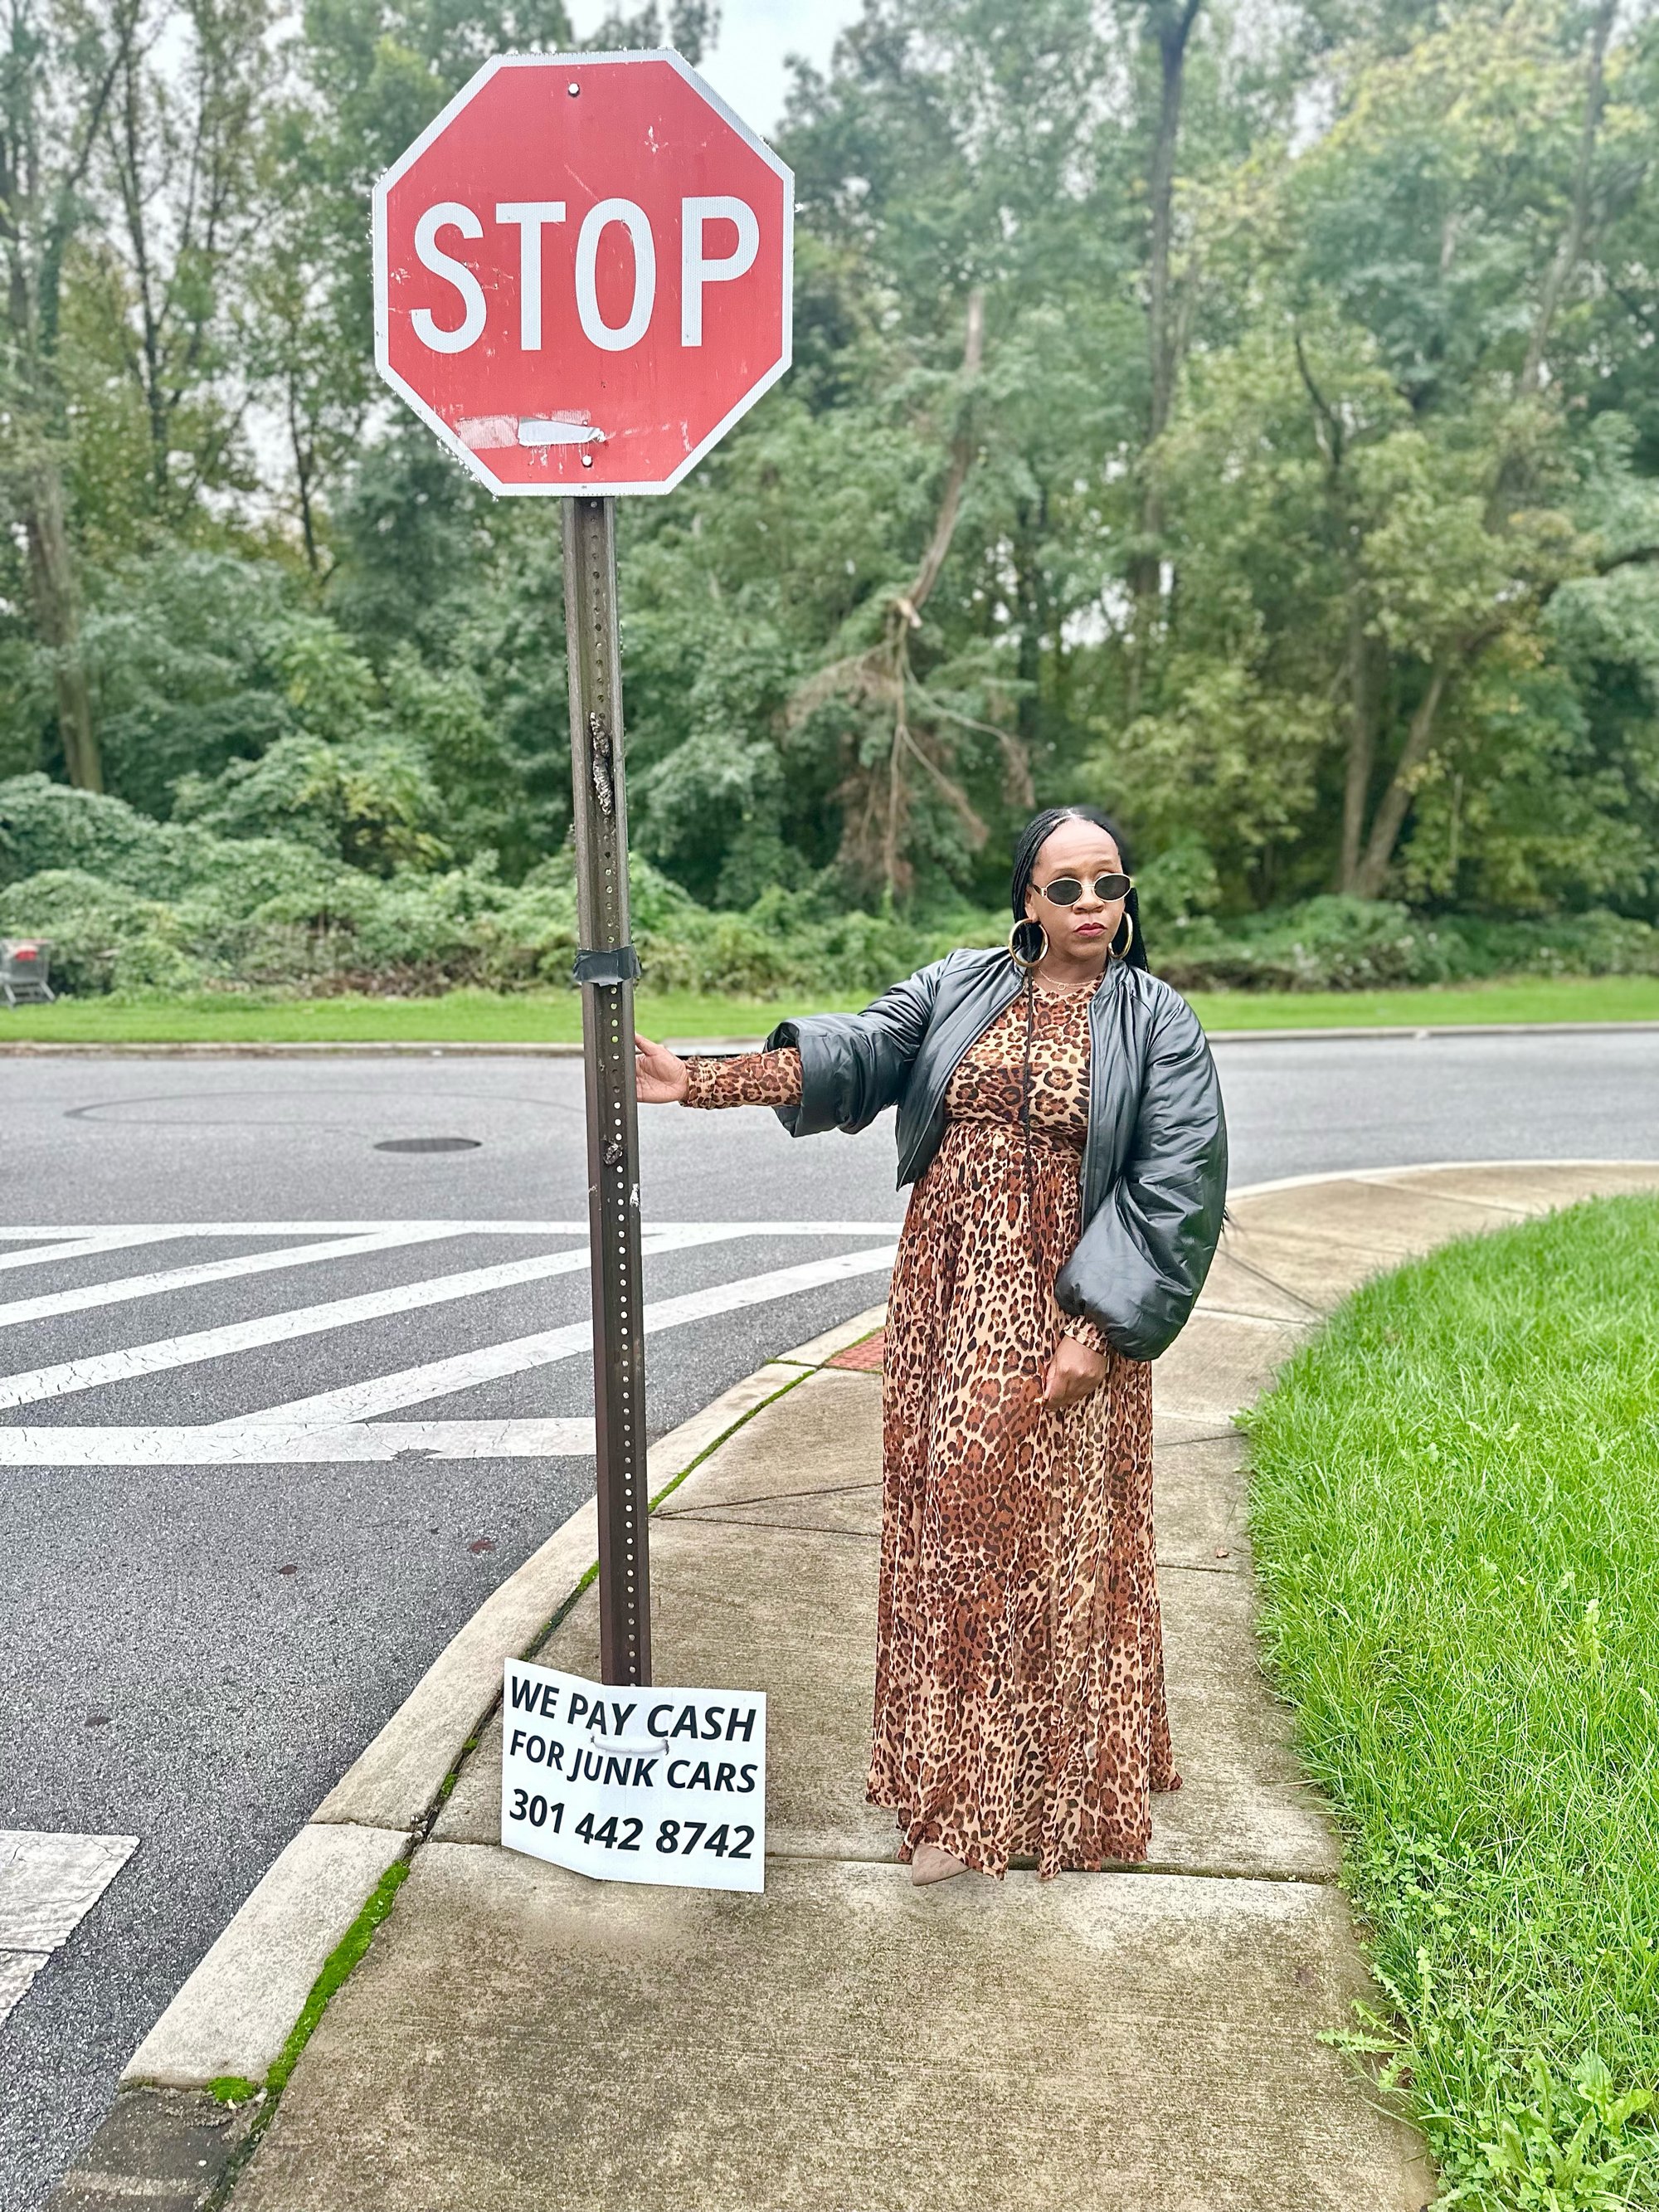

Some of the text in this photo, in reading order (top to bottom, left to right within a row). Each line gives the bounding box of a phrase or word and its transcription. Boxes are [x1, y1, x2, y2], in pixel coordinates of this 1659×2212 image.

[411, 195, 760, 354] STOP
[512, 1675, 757, 1742] WE PAY CASH
[509, 1728, 758, 1793] FOR JUNK CARS
[509, 1788, 755, 1859] 301 442 8742
